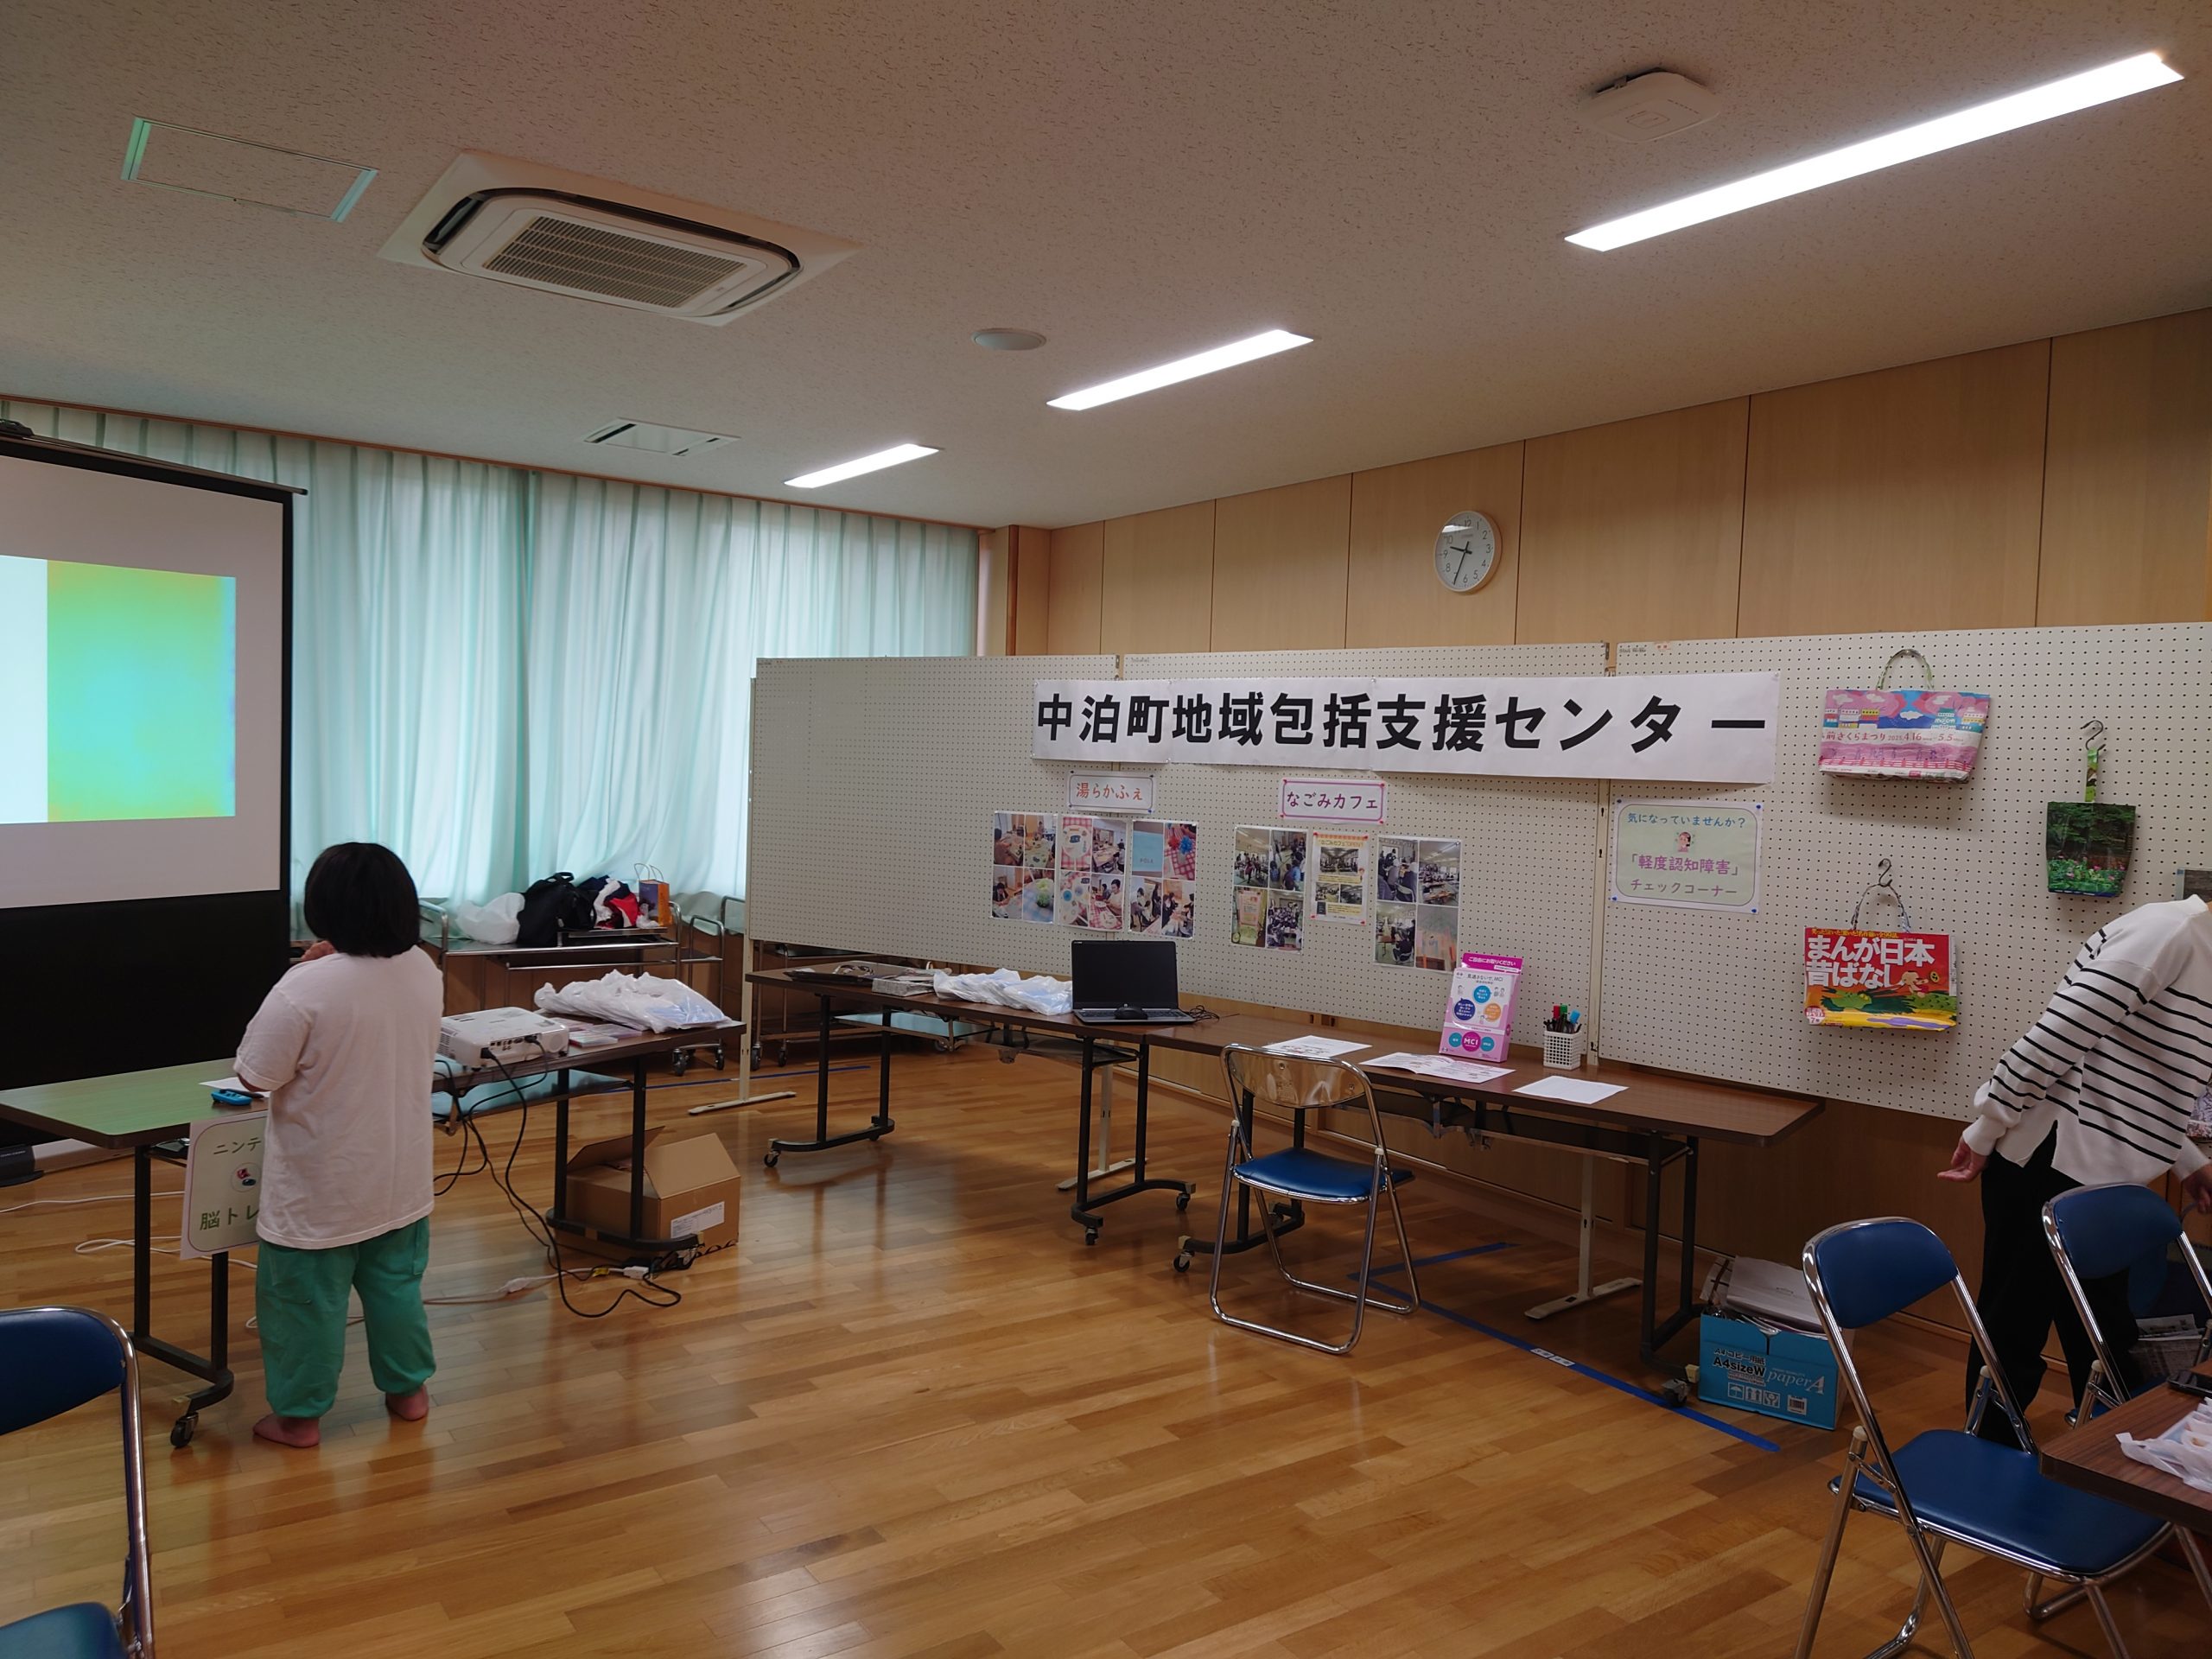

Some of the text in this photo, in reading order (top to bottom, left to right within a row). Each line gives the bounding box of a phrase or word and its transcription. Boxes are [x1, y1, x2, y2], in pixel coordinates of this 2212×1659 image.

[1482, 531, 1487, 540] 2
[1443, 550, 1448, 559] 9
[1486, 543, 1491, 553] 3
[1446, 563, 1451, 572] 8
[1473, 569, 1478, 580] 5
[1463, 574, 1468, 583] 6
[1037, 691, 1766, 753] 中泊町地域包括支援センター
[1822, 732, 1885, 741] 前さくらまつり
[1287, 791, 1378, 810] なごみカフェ
[1628, 812, 1745, 829] 気になっていませんか？
[1631, 853, 1738, 876] 「軽度認知障害」
[1630, 878, 1737, 897] チェックコーナー
[1808, 935, 1936, 967] まんが日本
[1806, 959, 1905, 989] 昔ばなし
[200, 1205, 259, 1231] 脳トレ
[1713, 1357, 1765, 1376] A4sizeW
